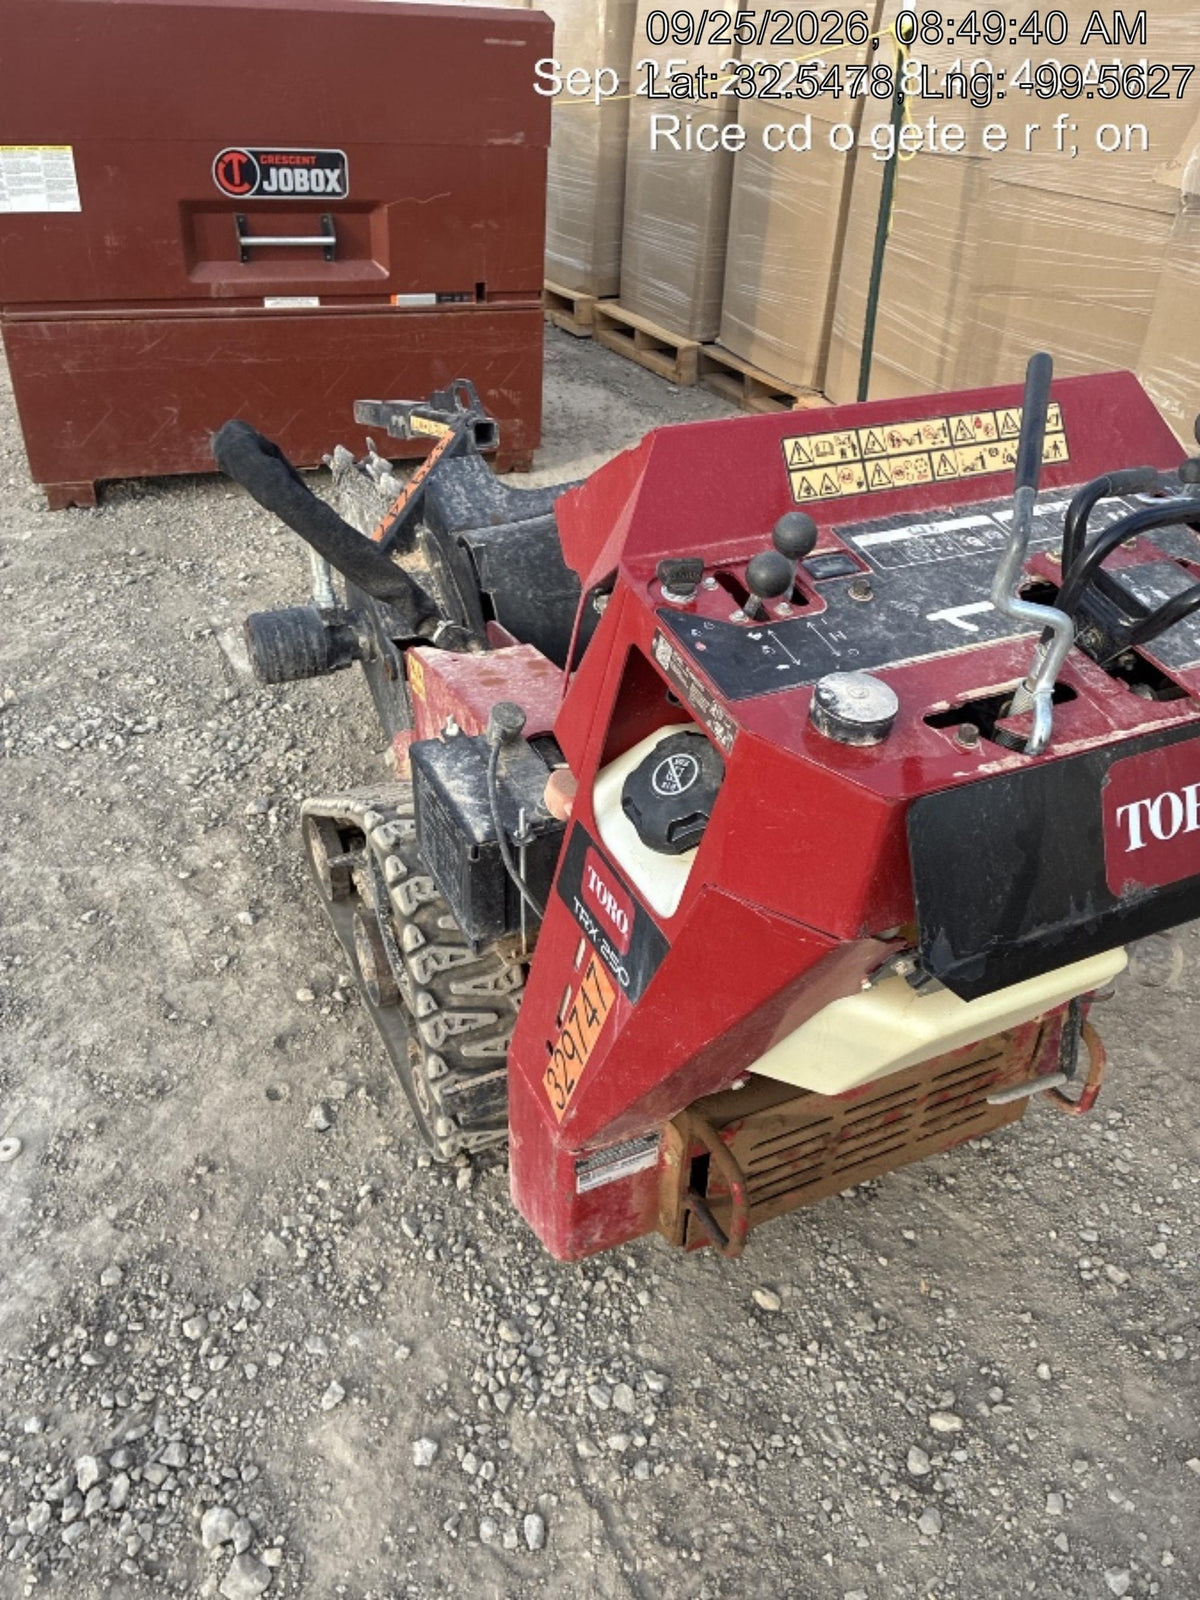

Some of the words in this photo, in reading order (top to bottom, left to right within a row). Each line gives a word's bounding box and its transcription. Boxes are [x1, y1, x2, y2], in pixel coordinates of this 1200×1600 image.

[260, 154, 317, 165] CRESCENT
[262, 167, 343, 193] JOBOX
[587, 864, 630, 935] TORO
[546, 960, 608, 1110] 329747
